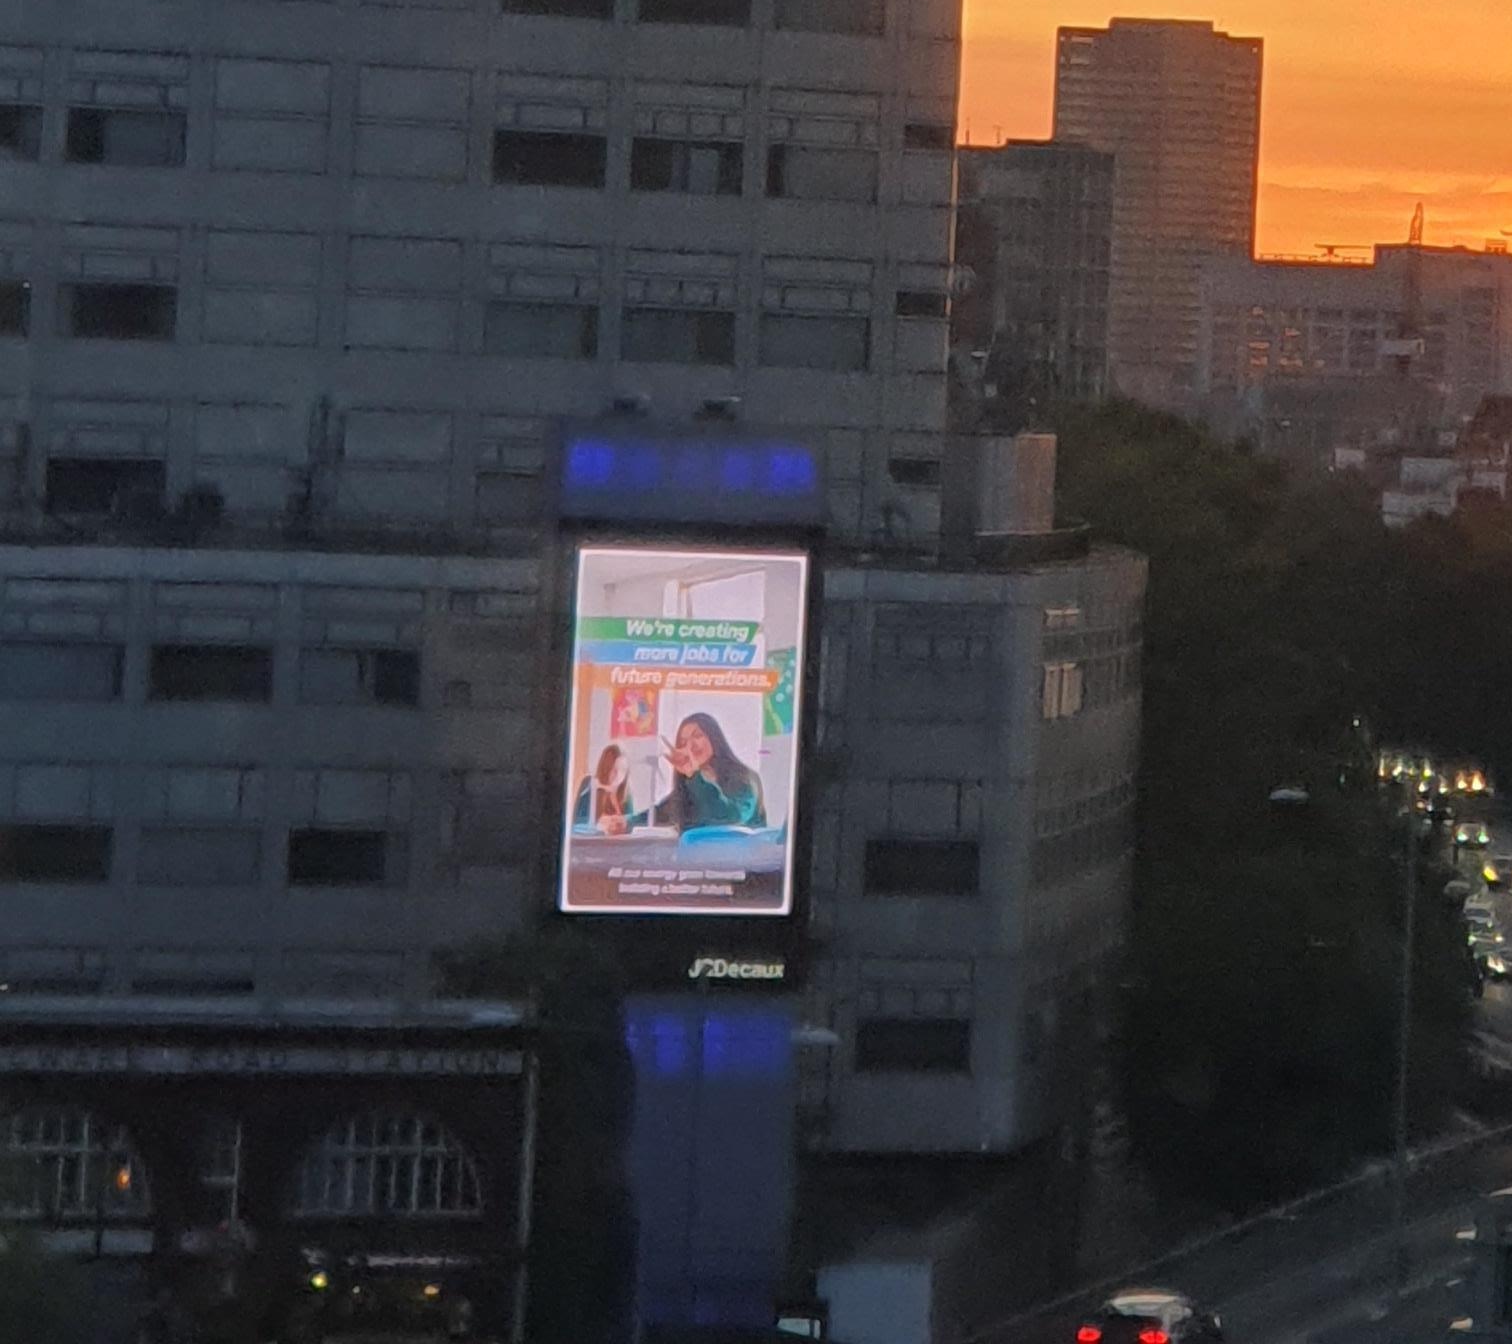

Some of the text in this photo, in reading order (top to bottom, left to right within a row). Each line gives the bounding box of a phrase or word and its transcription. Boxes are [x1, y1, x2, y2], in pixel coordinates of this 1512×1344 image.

[626, 620, 749, 642] We're creating
[634, 644, 748, 664] more jobs for
[611, 667, 662, 685] future
